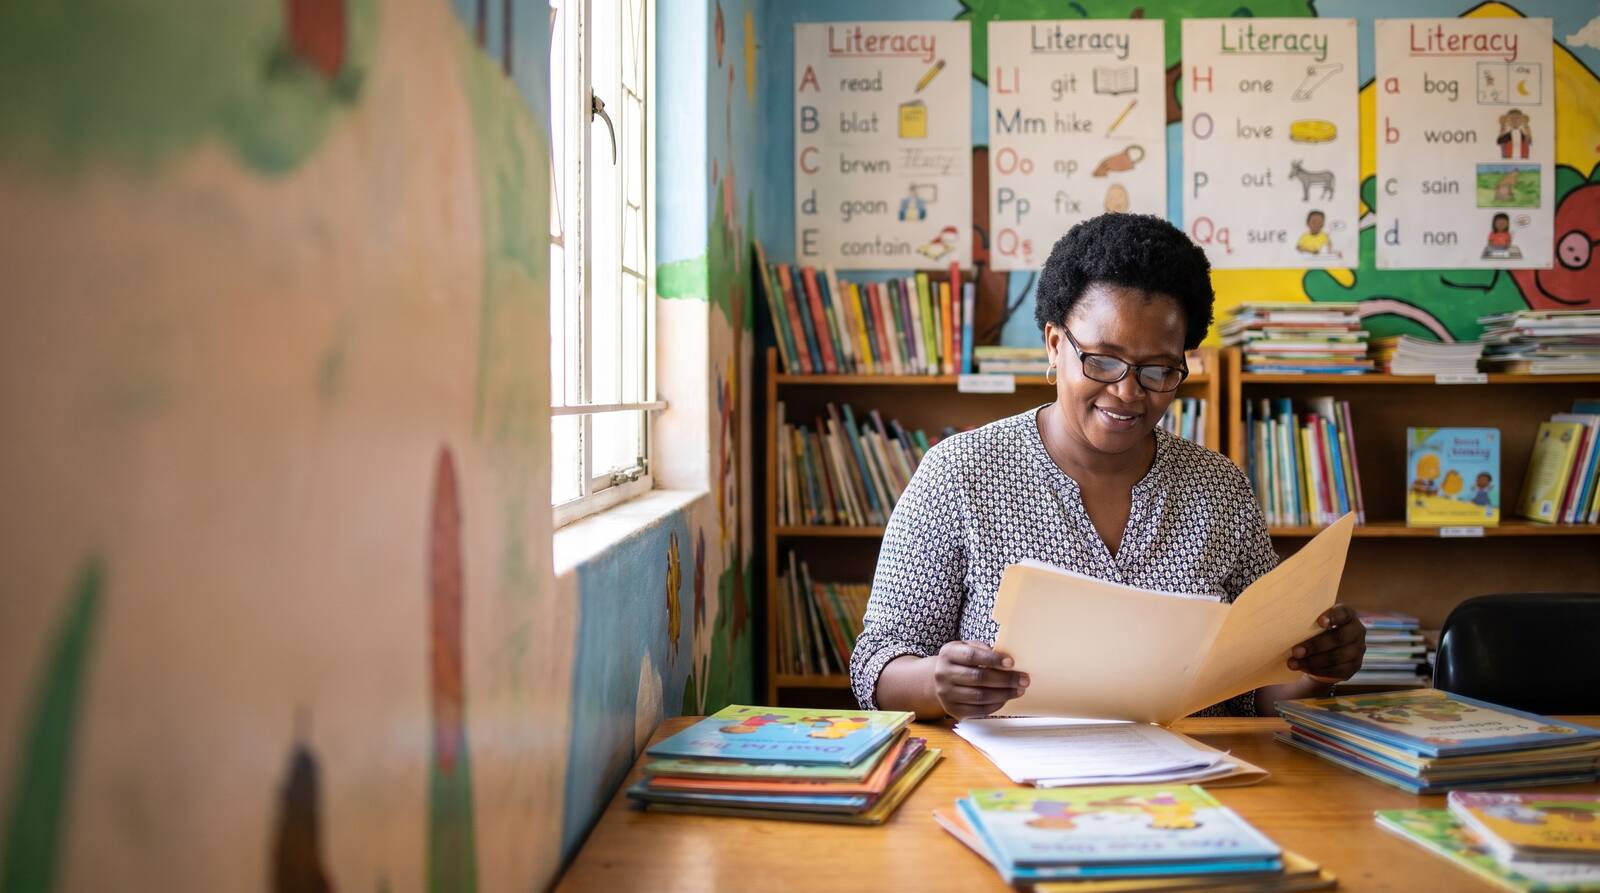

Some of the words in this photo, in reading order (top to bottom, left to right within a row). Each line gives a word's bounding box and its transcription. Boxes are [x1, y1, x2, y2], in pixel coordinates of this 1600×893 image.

[828, 25, 936, 62] Literacy
[1031, 25, 1129, 60] Literacy
[1220, 23, 1327, 61] Literacy
[1410, 23, 1517, 62] Literacy
[798, 64, 821, 93] A
[839, 70, 883, 92] read
[1050, 74, 1078, 101] git
[1192, 66, 1214, 93] H
[1238, 78, 1274, 93] one
[1384, 75, 1400, 94] a
[1423, 72, 1459, 102] bog
[800, 106, 820, 134] B
[840, 112, 879, 134] blat
[995, 109, 1047, 134] Mm
[1054, 111, 1092, 133] hike
[1236, 117, 1274, 139] love
[1385, 117, 1400, 145] b
[1424, 128, 1478, 145] woon
[995, 147, 1034, 175] Oo
[1241, 168, 1274, 188] out
[1421, 176, 1460, 195] sain
[801, 189, 818, 216] d
[997, 187, 1031, 224] Pp
[1054, 190, 1081, 214] fix
[801, 228, 820, 256] E
[840, 235, 912, 257] contain
[1191, 216, 1233, 255] Qq
[1247, 227, 1287, 244] sure
[1384, 218, 1400, 246] d
[1422, 229, 1458, 246] non
